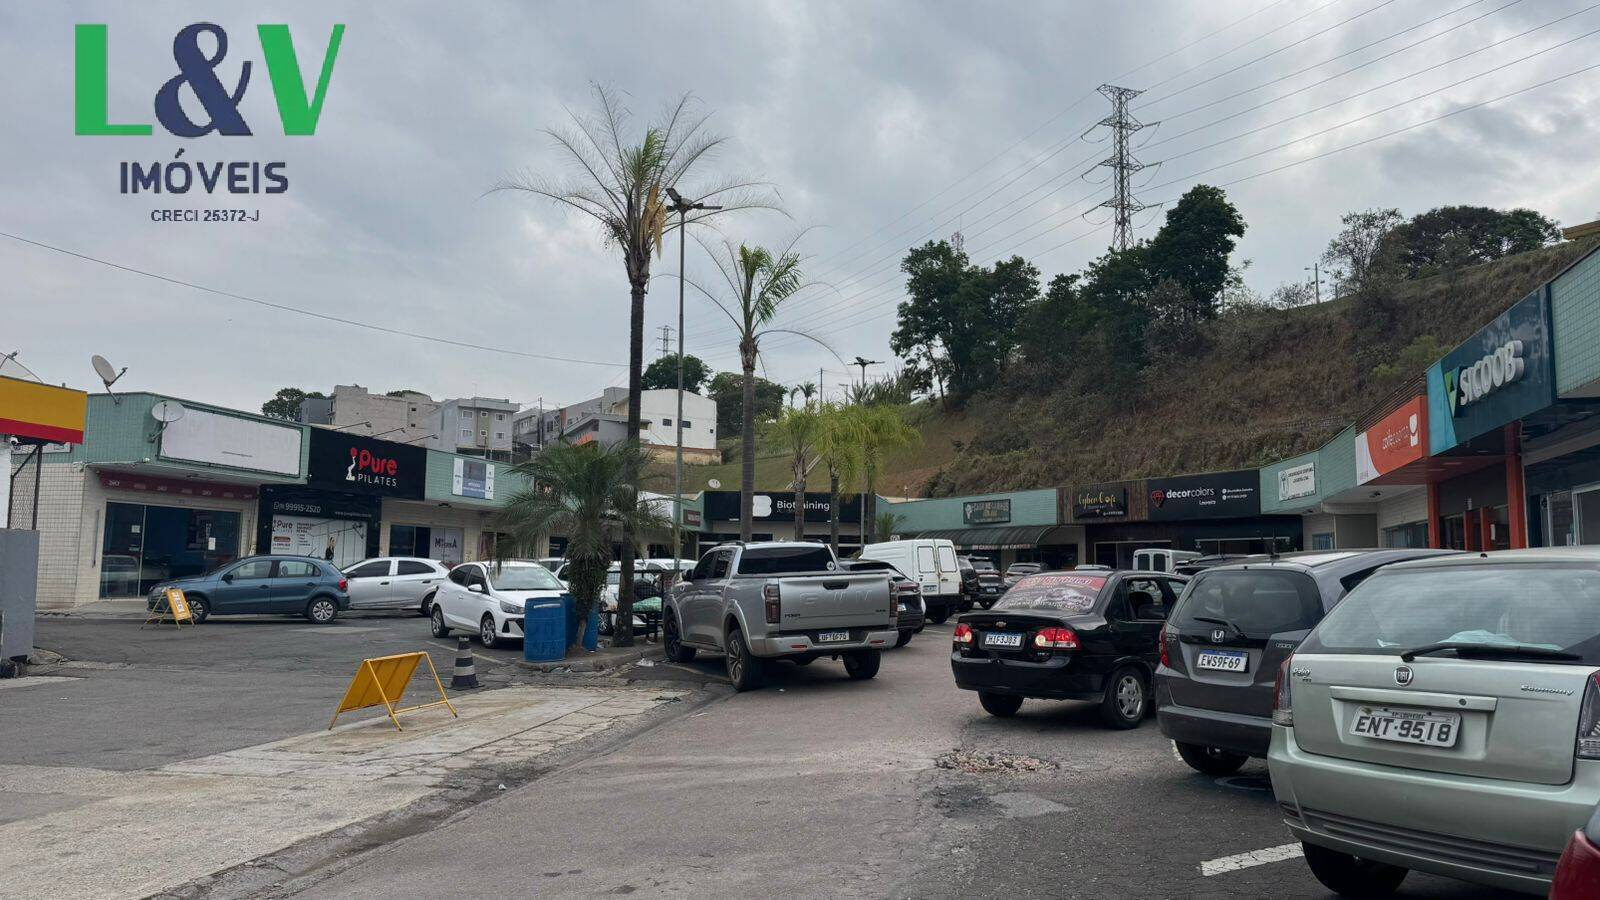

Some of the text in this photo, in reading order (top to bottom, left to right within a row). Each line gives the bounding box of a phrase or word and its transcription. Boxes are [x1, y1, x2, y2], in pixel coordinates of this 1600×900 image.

[1460, 340, 1523, 406] SICOOB
[358, 449, 398, 476] Pure
[357, 473, 397, 487] PILATES
[1166, 486, 1215, 499] decorcolors
[1201, 654, 1241, 669] EWS9F69
[1397, 671, 1409, 680] FIAT
[1521, 684, 1575, 696] Economy
